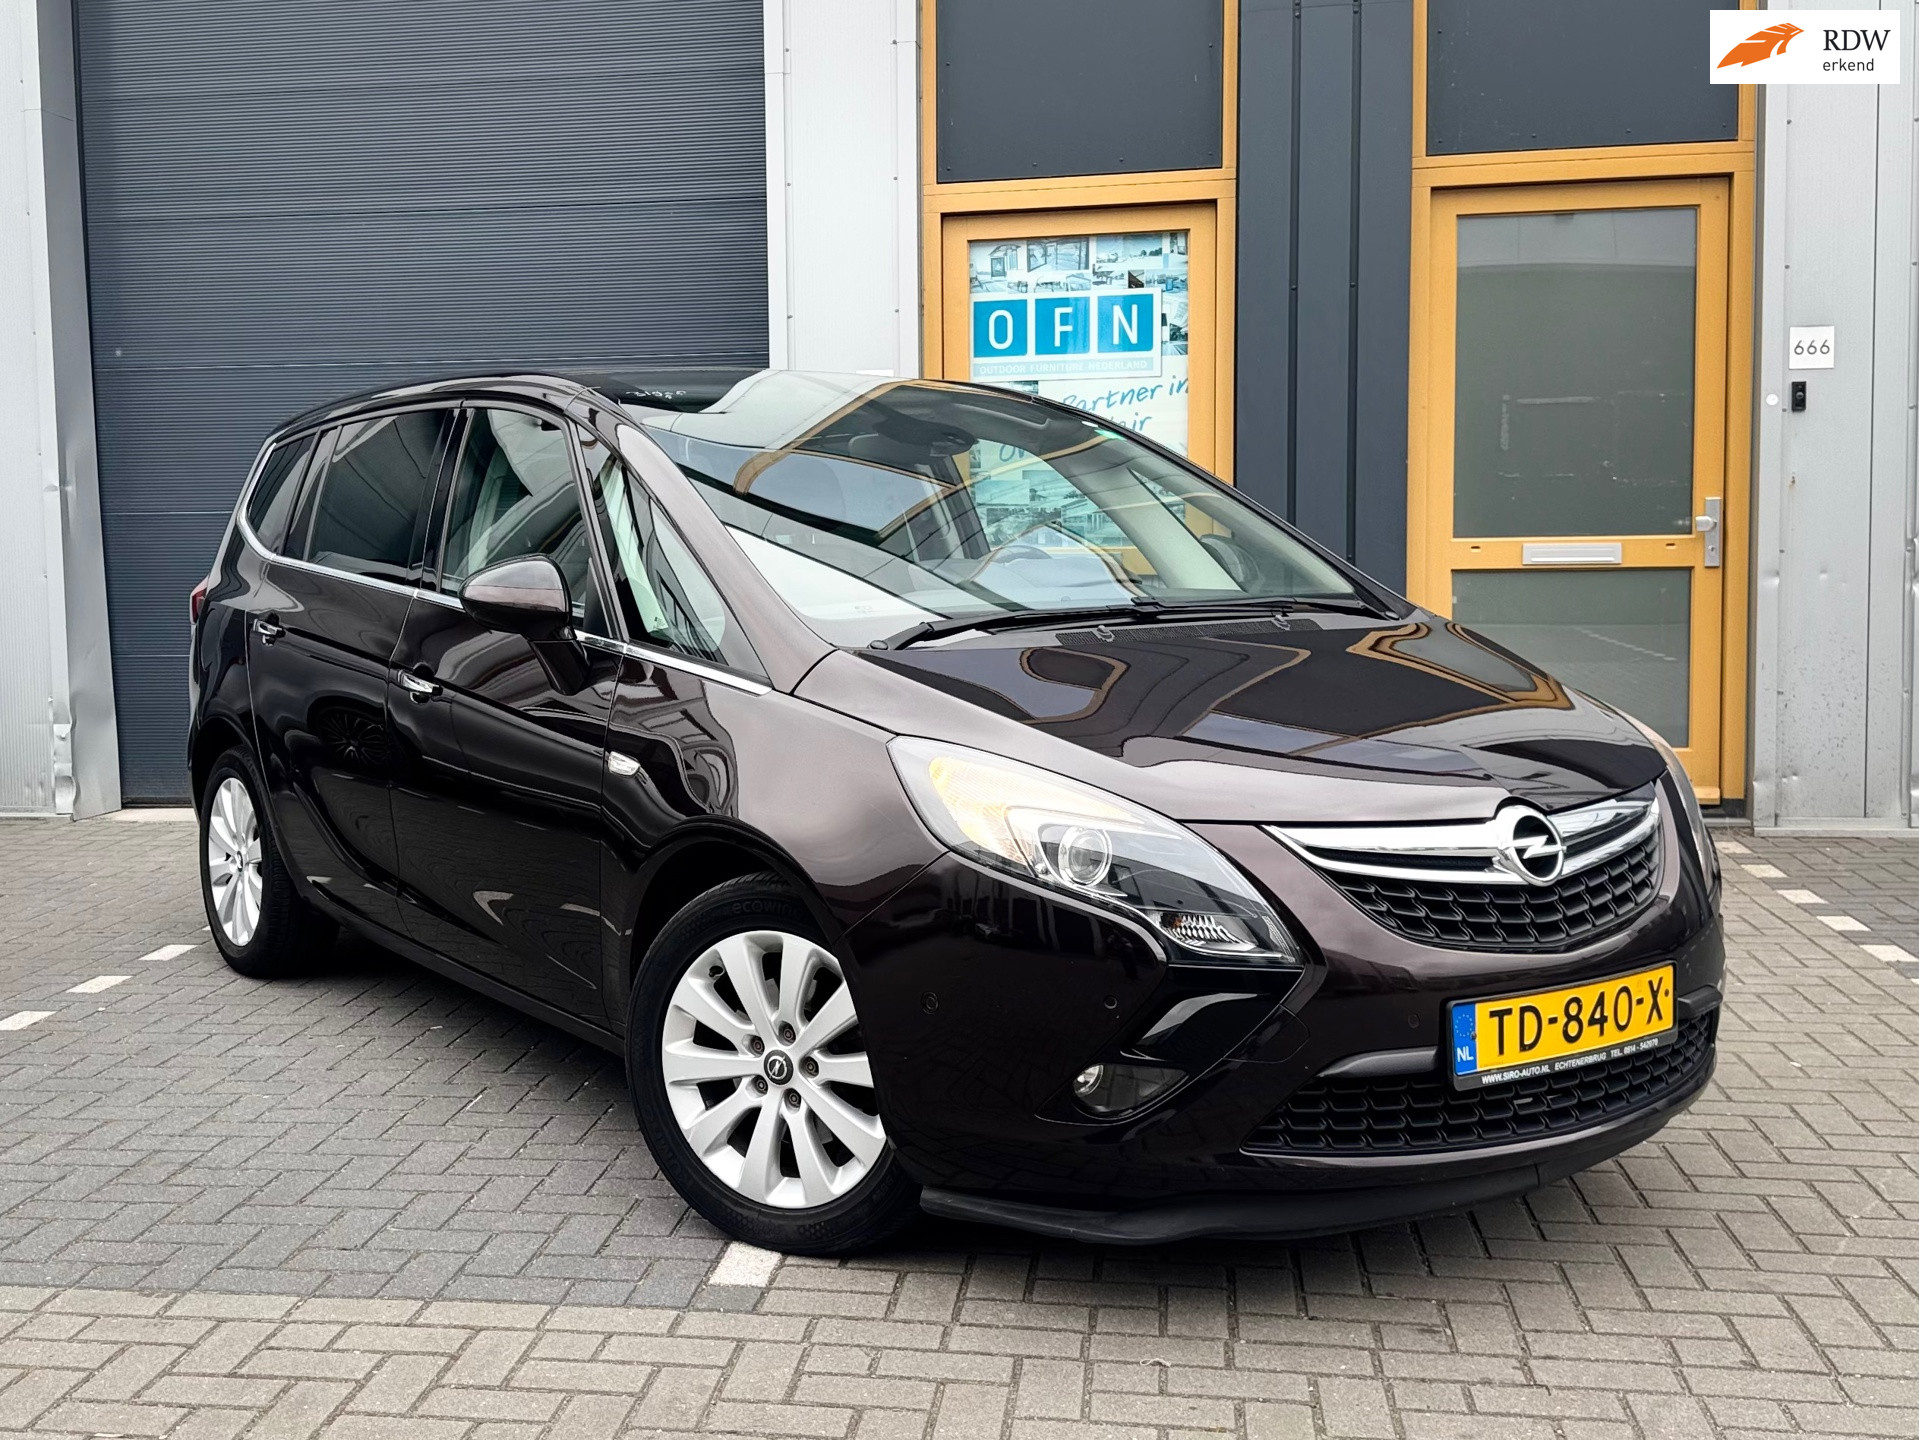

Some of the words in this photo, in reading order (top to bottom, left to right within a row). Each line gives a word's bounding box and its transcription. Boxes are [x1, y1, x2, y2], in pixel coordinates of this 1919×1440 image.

[1793, 339, 1830, 355] 666
[979, 364, 1026, 375] OUTDOOR
[1030, 361, 1084, 373] FURNITURE
[1088, 359, 1148, 371] NEDERLAND
[1489, 976, 1664, 1057] TD-840-X
[1457, 1045, 1475, 1063] NL
[1554, 1052, 1607, 1070] ECHTENERBRUG
